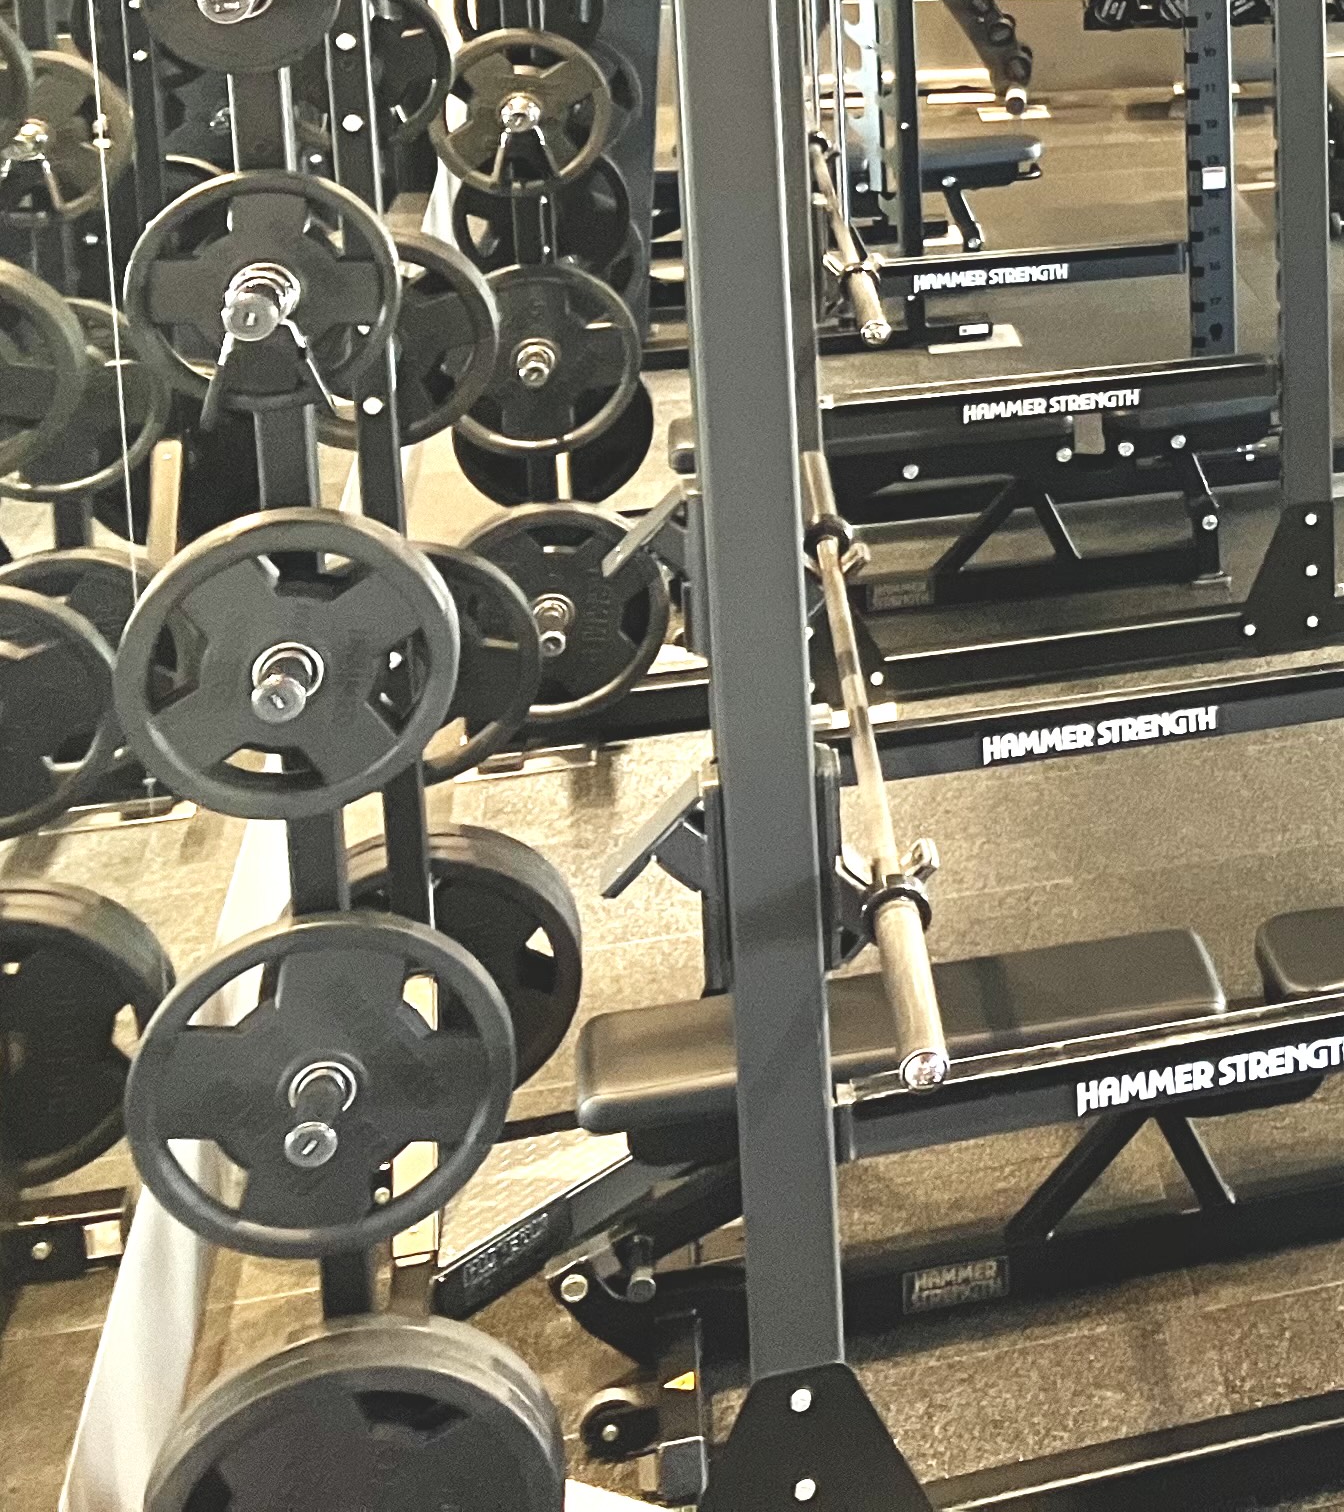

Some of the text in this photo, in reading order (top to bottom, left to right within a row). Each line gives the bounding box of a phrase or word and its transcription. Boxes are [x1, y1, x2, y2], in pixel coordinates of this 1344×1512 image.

[913, 263, 1069, 294] HAMMER STRENGTH
[963, 388, 1141, 424] HAMMER STRENGTH
[982, 705, 1219, 765] HAMMER STRENGTH
[1077, 1061, 1214, 1117] HAMMER
